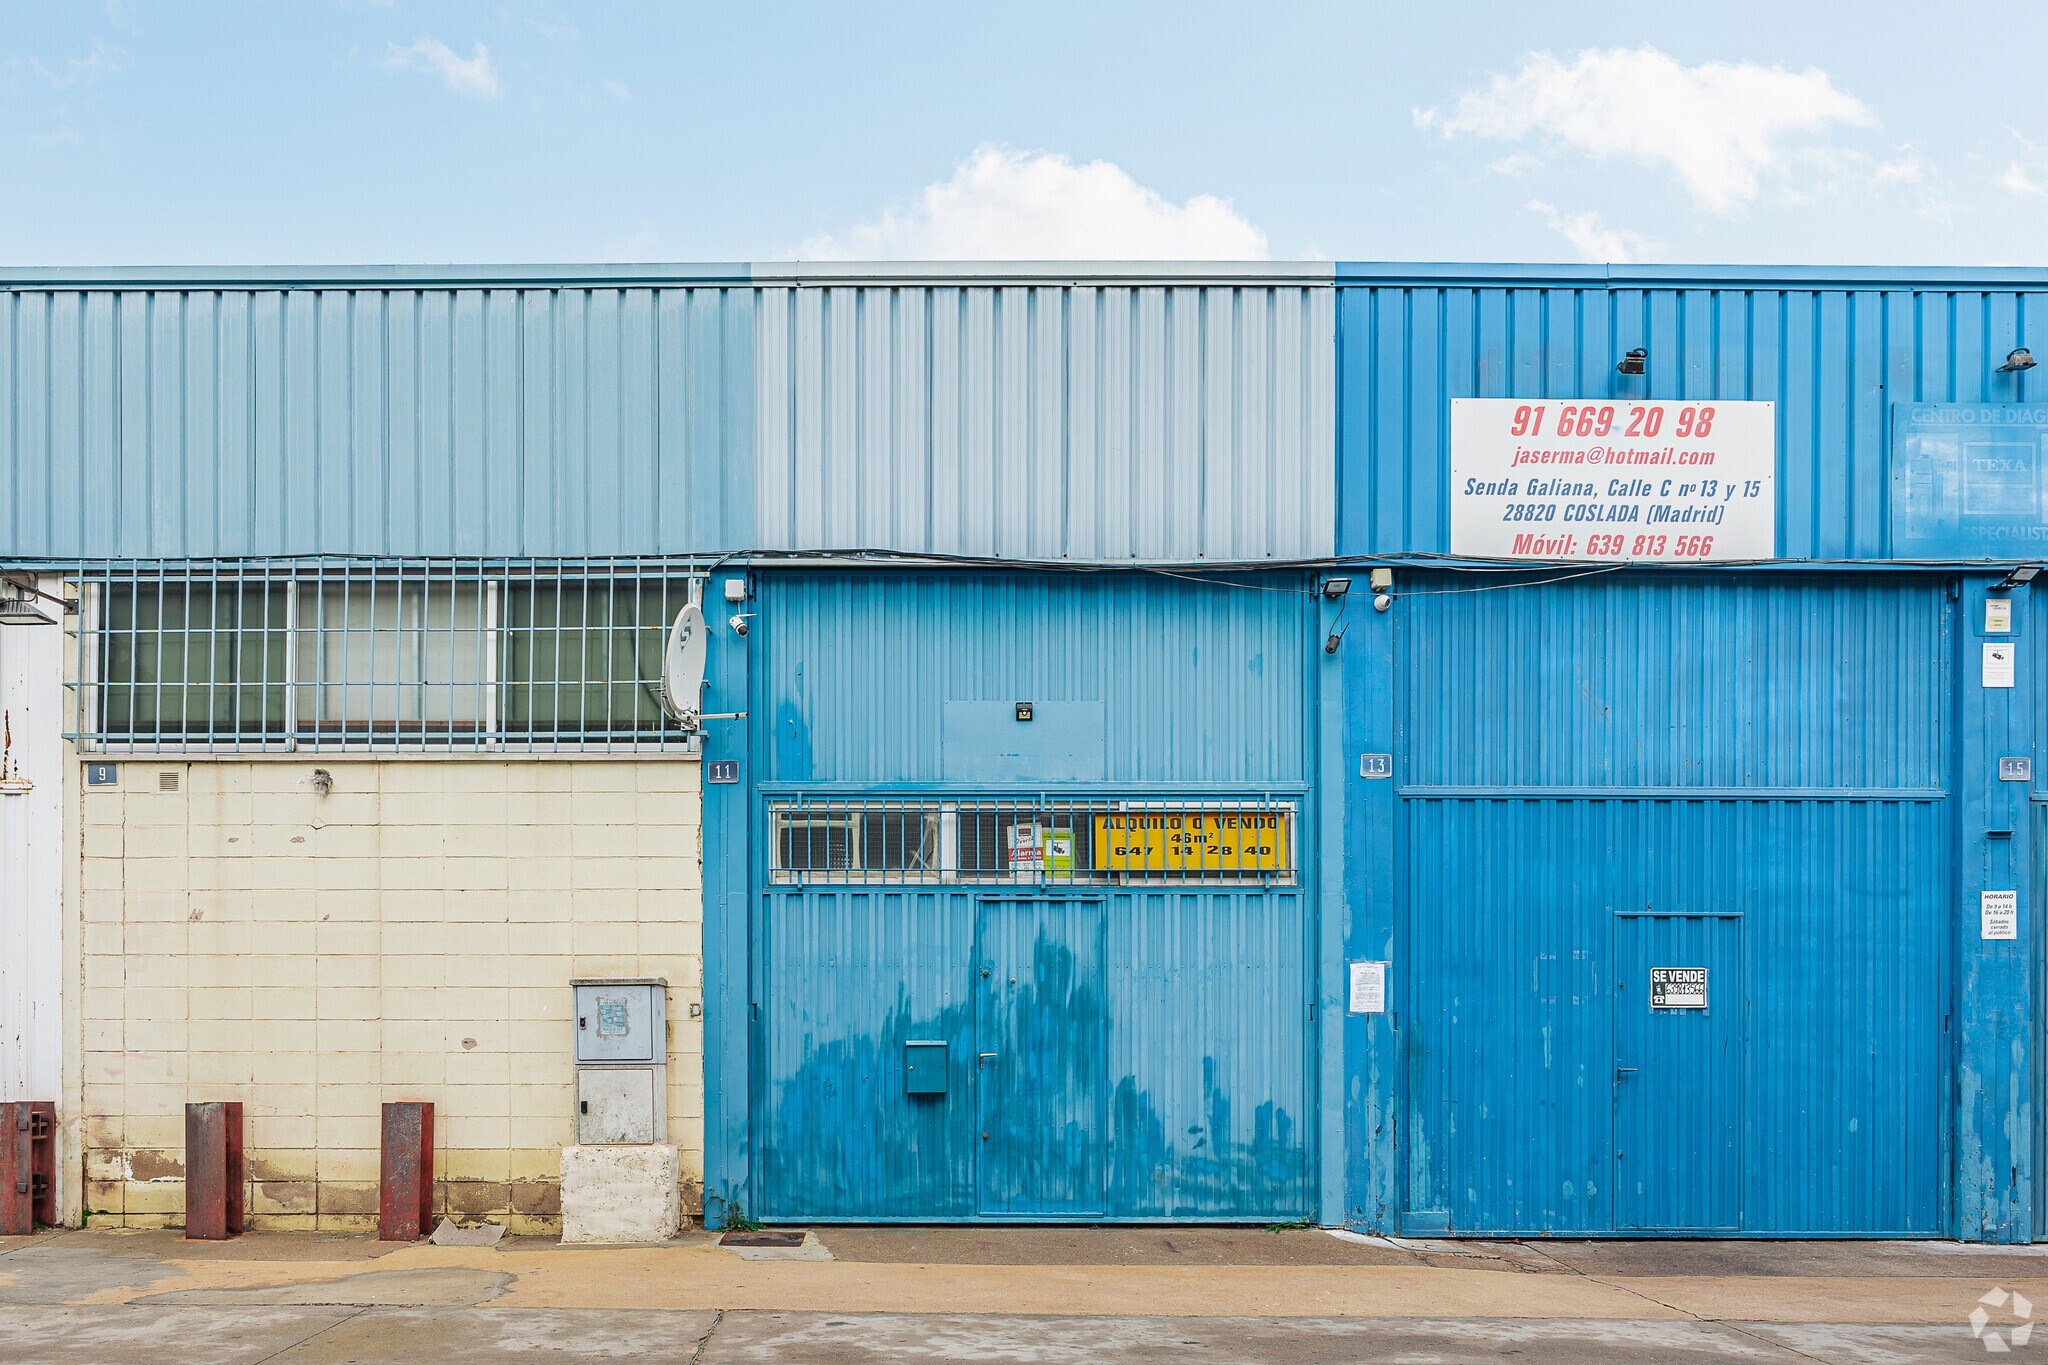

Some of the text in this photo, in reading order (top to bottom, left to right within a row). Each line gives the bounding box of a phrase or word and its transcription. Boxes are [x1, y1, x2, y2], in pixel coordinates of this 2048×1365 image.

[1510, 405, 1716, 438] 91 669 20 98
[1910, 408, 2048, 423] CENTRO DE DIAG
[1511, 446, 1716, 468] jaserma@hotmail.com
[1971, 458, 2028, 472] TEXA
[1464, 477, 1519, 496] Senda
[1526, 478, 1598, 499] Galiana,
[1607, 479, 1652, 497] Calle
[1659, 479, 1672, 497] C
[1724, 484, 1736, 501] y
[1743, 480, 1761, 498] 15
[1502, 503, 1725, 525] 28820 COSLADA (Madrid)
[1511, 533, 1714, 557] Móvil: 639 813 566
[715, 764, 731, 779] 11
[1369, 758, 1385, 773] 13
[2007, 762, 2024, 776] 15
[99, 767, 106, 781] 9
[1102, 817, 1278, 832] ALQUILO O VENDO
[1114, 845, 1271, 856] 647 14 28 40
[1653, 971, 1704, 982] SE VENDE
